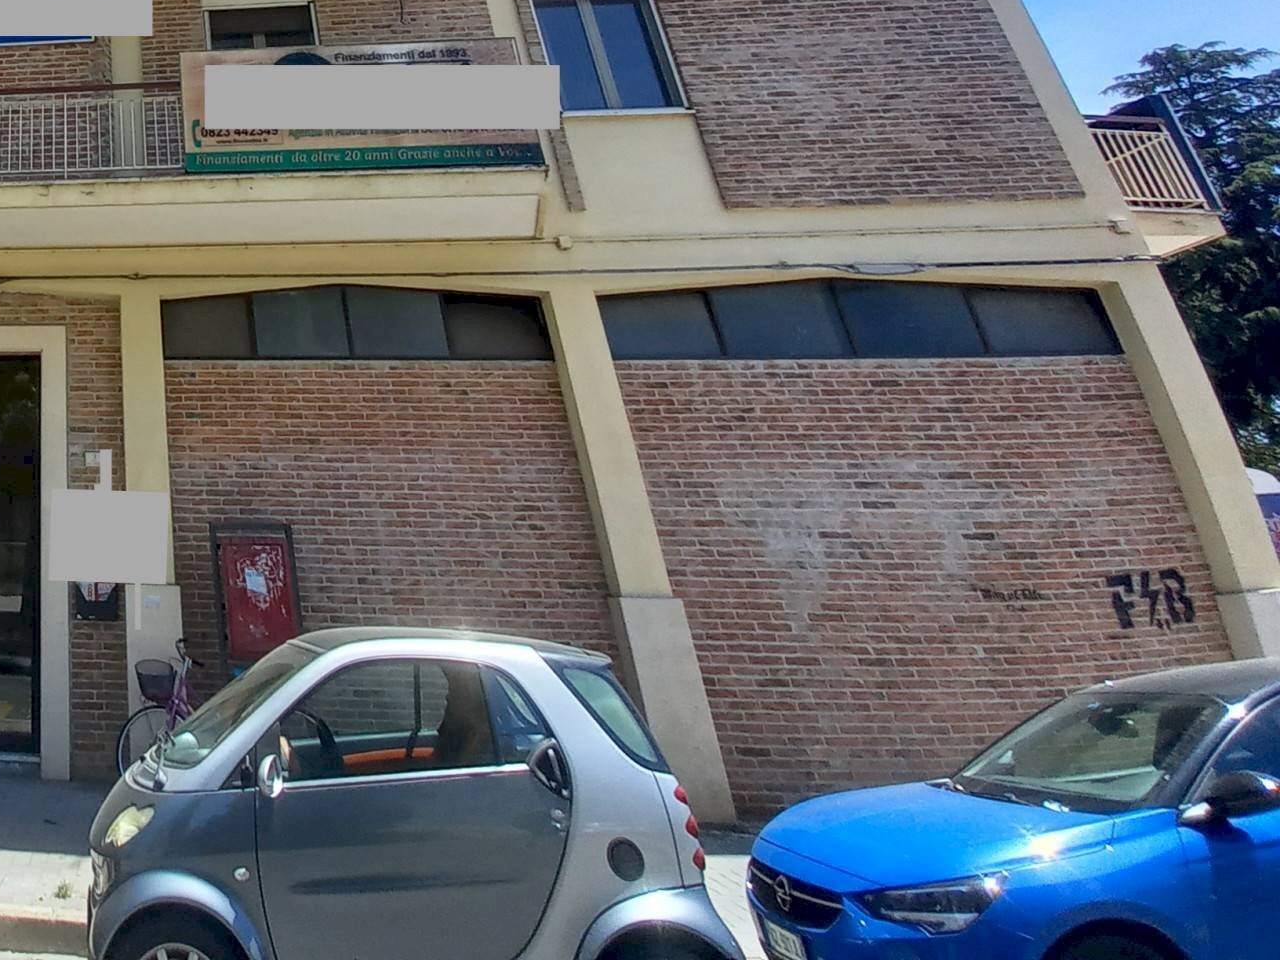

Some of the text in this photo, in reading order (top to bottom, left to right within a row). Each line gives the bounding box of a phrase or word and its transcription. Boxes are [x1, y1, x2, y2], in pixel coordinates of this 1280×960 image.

[334, 49, 415, 62] Finanziamenti
[418, 48, 437, 60] dal
[195, 152, 284, 165] Finanziamenti
[291, 151, 309, 163] da
[311, 150, 341, 162] oltre
[344, 150, 361, 161] 20
[364, 150, 393, 161] anni
[398, 148, 439, 160] Grazie
[443, 147, 481, 158] anche
[486, 148, 494, 158] a
